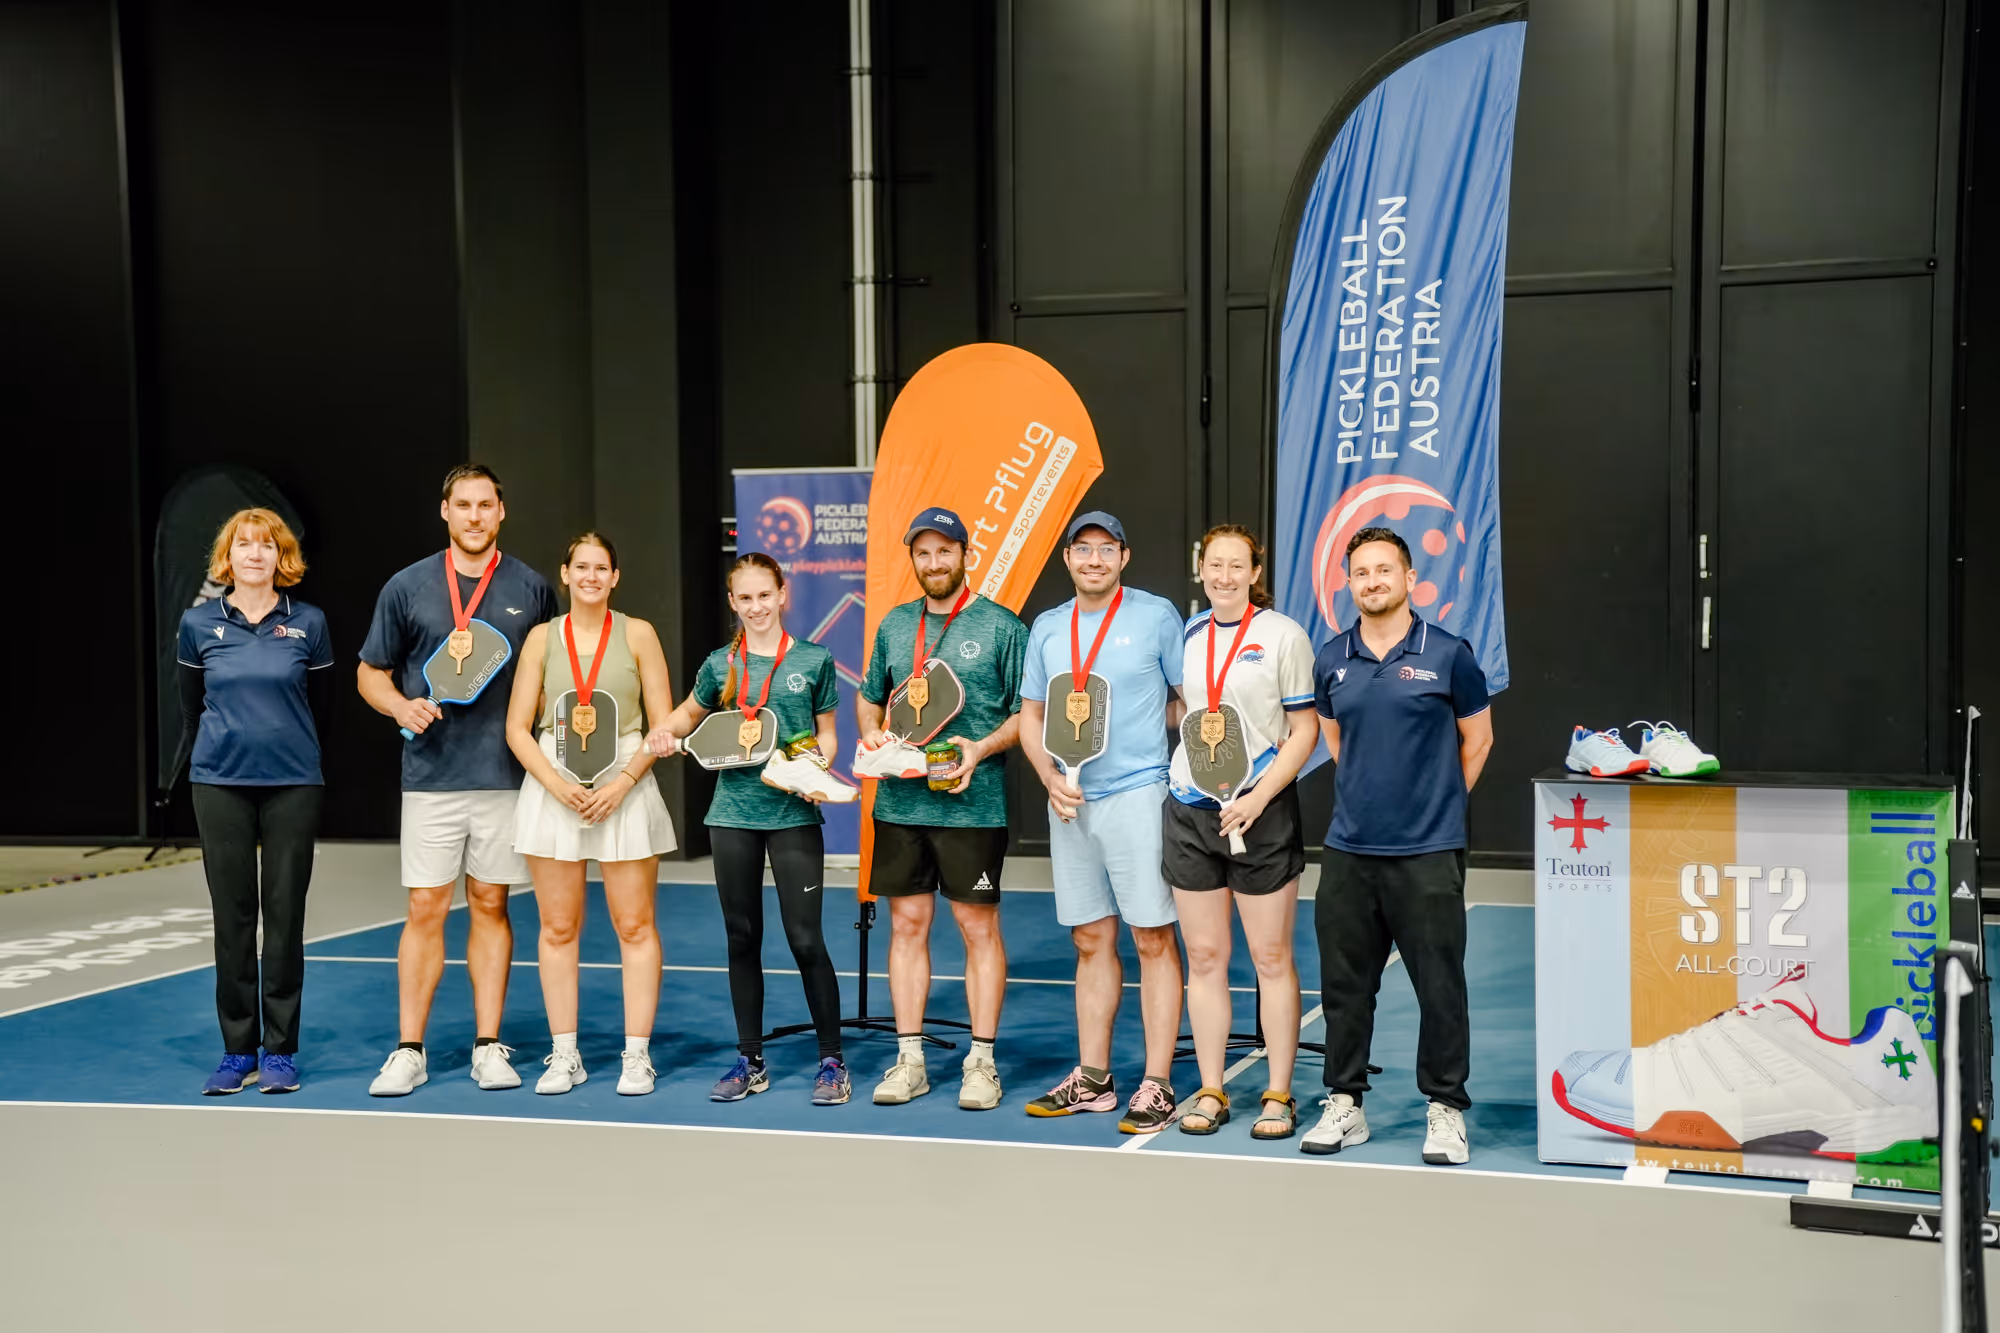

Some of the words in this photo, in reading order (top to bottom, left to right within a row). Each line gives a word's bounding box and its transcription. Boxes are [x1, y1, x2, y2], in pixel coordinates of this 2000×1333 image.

[1336, 219, 1369, 464] PICKLEBALL
[1371, 195, 1408, 460] FEDERATION
[1410, 278, 1443, 458] AUSTRIA
[984, 421, 1054, 514] Pflug
[1013, 444, 1070, 538] Sportevents
[1074, 703, 1082, 715] 3
[1209, 724, 1217, 736] 3
[1547, 882, 1612, 893] SPORTS
[1679, 862, 1809, 949] ST2
[1675, 953, 1817, 979] ALL-COURT
